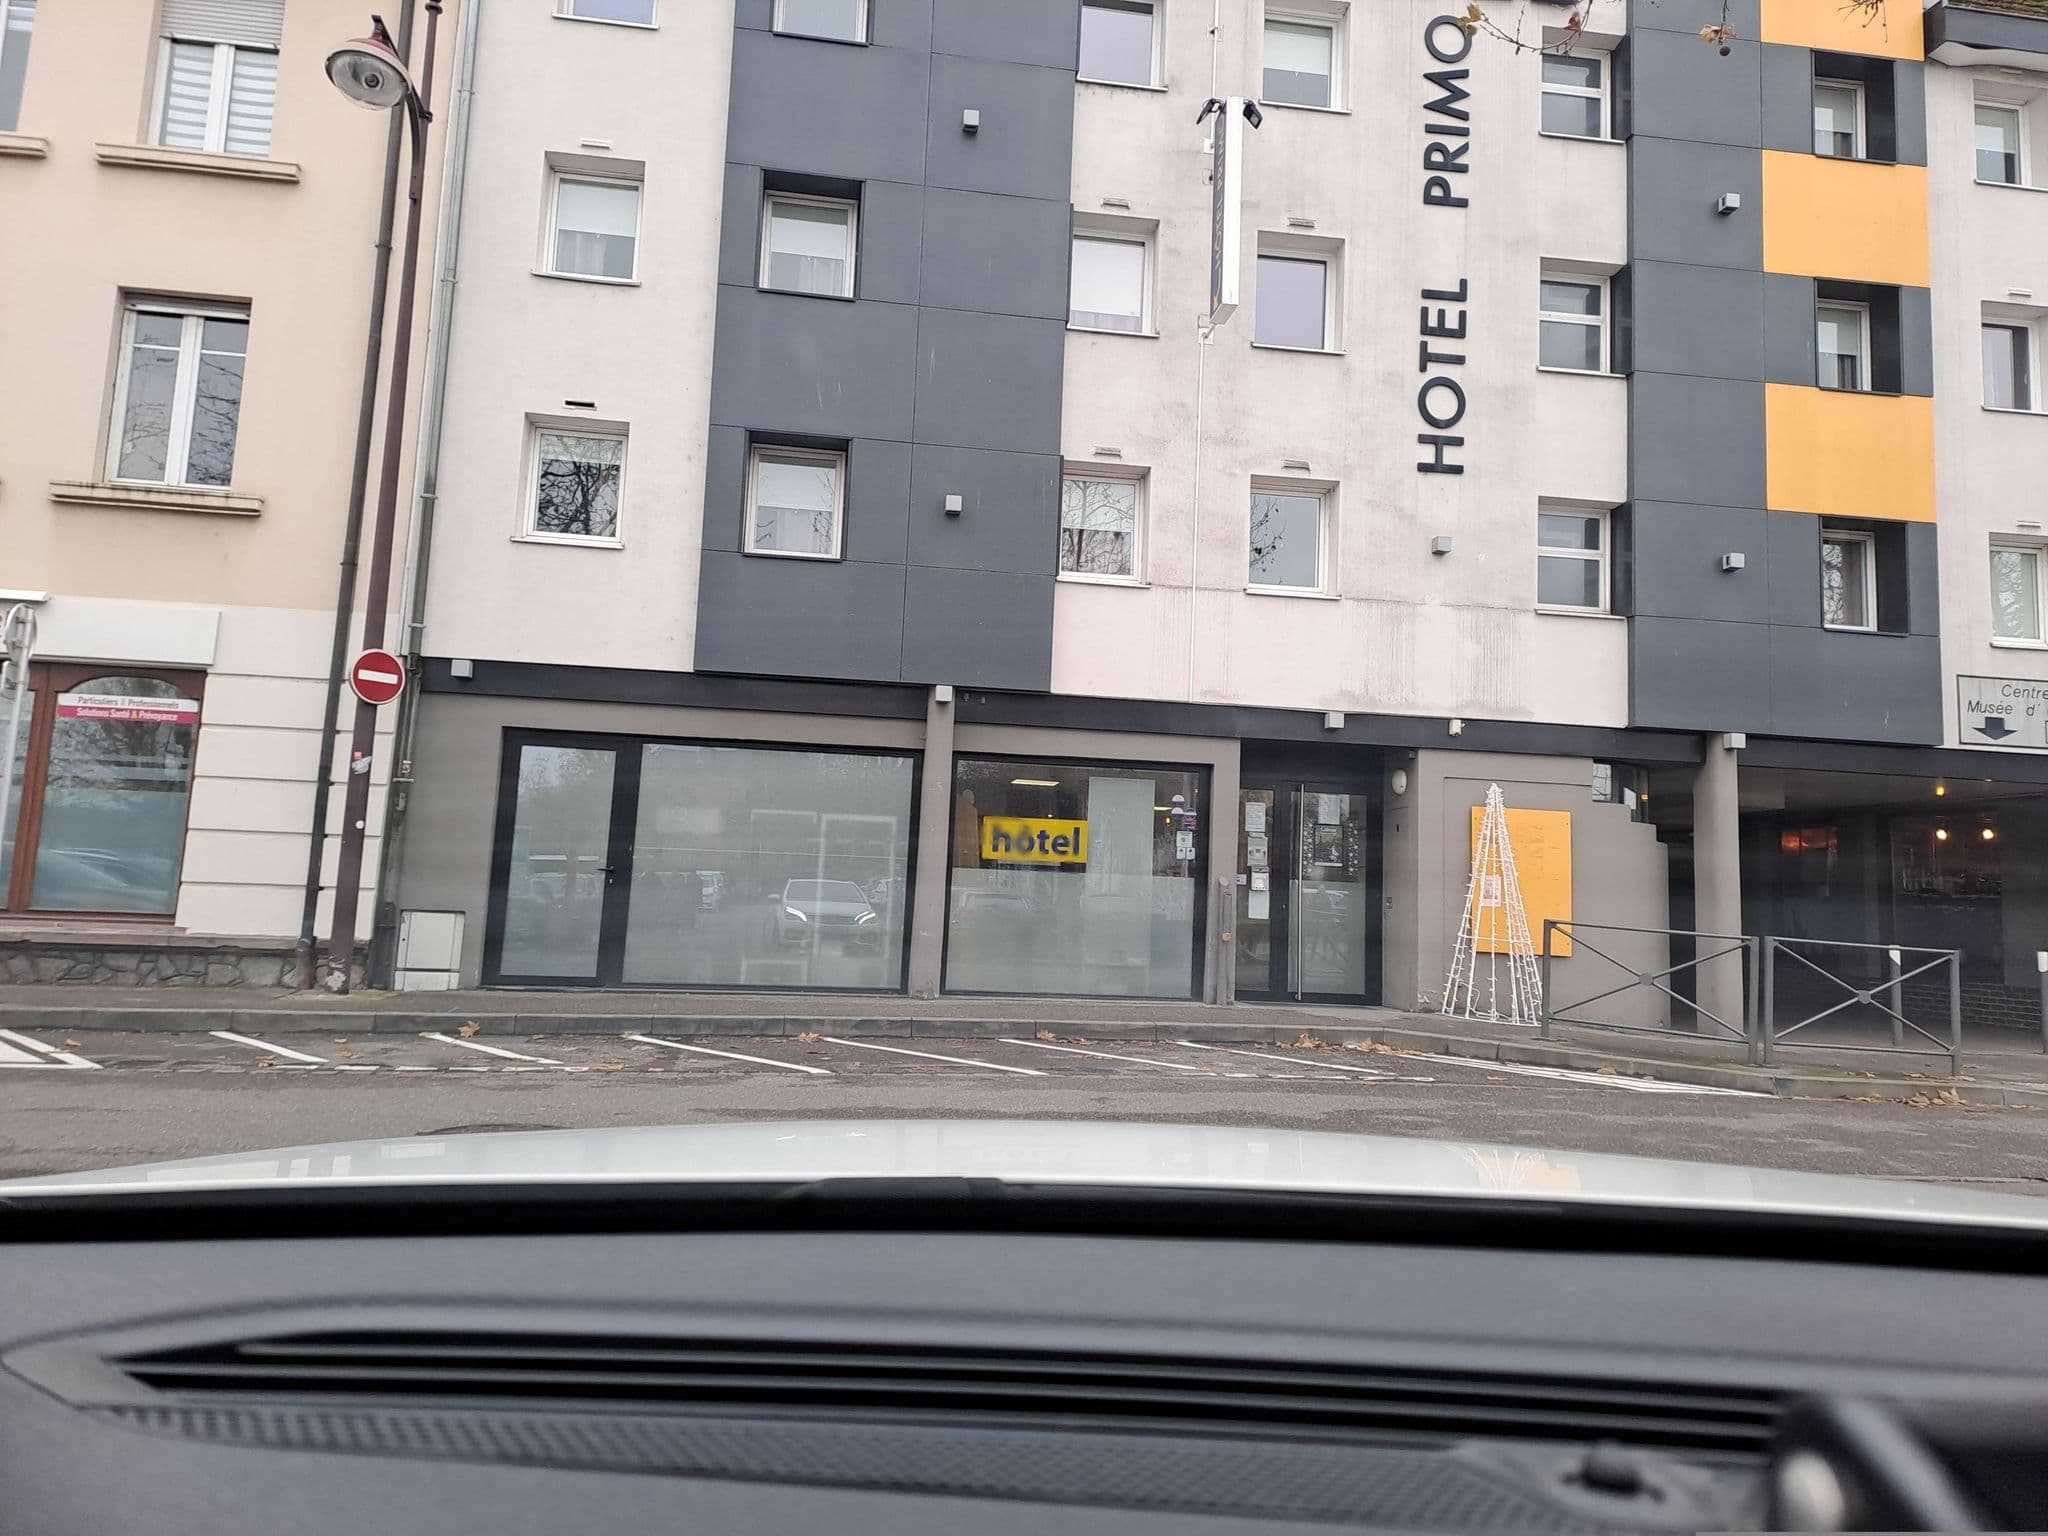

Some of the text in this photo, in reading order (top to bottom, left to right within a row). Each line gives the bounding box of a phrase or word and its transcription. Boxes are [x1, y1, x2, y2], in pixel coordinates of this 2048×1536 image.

[1417, 14, 1473, 475] HOTEL PRIMO
[2001, 683, 2048, 700] Centre
[76, 707, 109, 718] Solutions
[110, 708, 131, 719] Santé
[138, 710, 178, 722] Prévoyance
[1966, 699, 2013, 715] Musée
